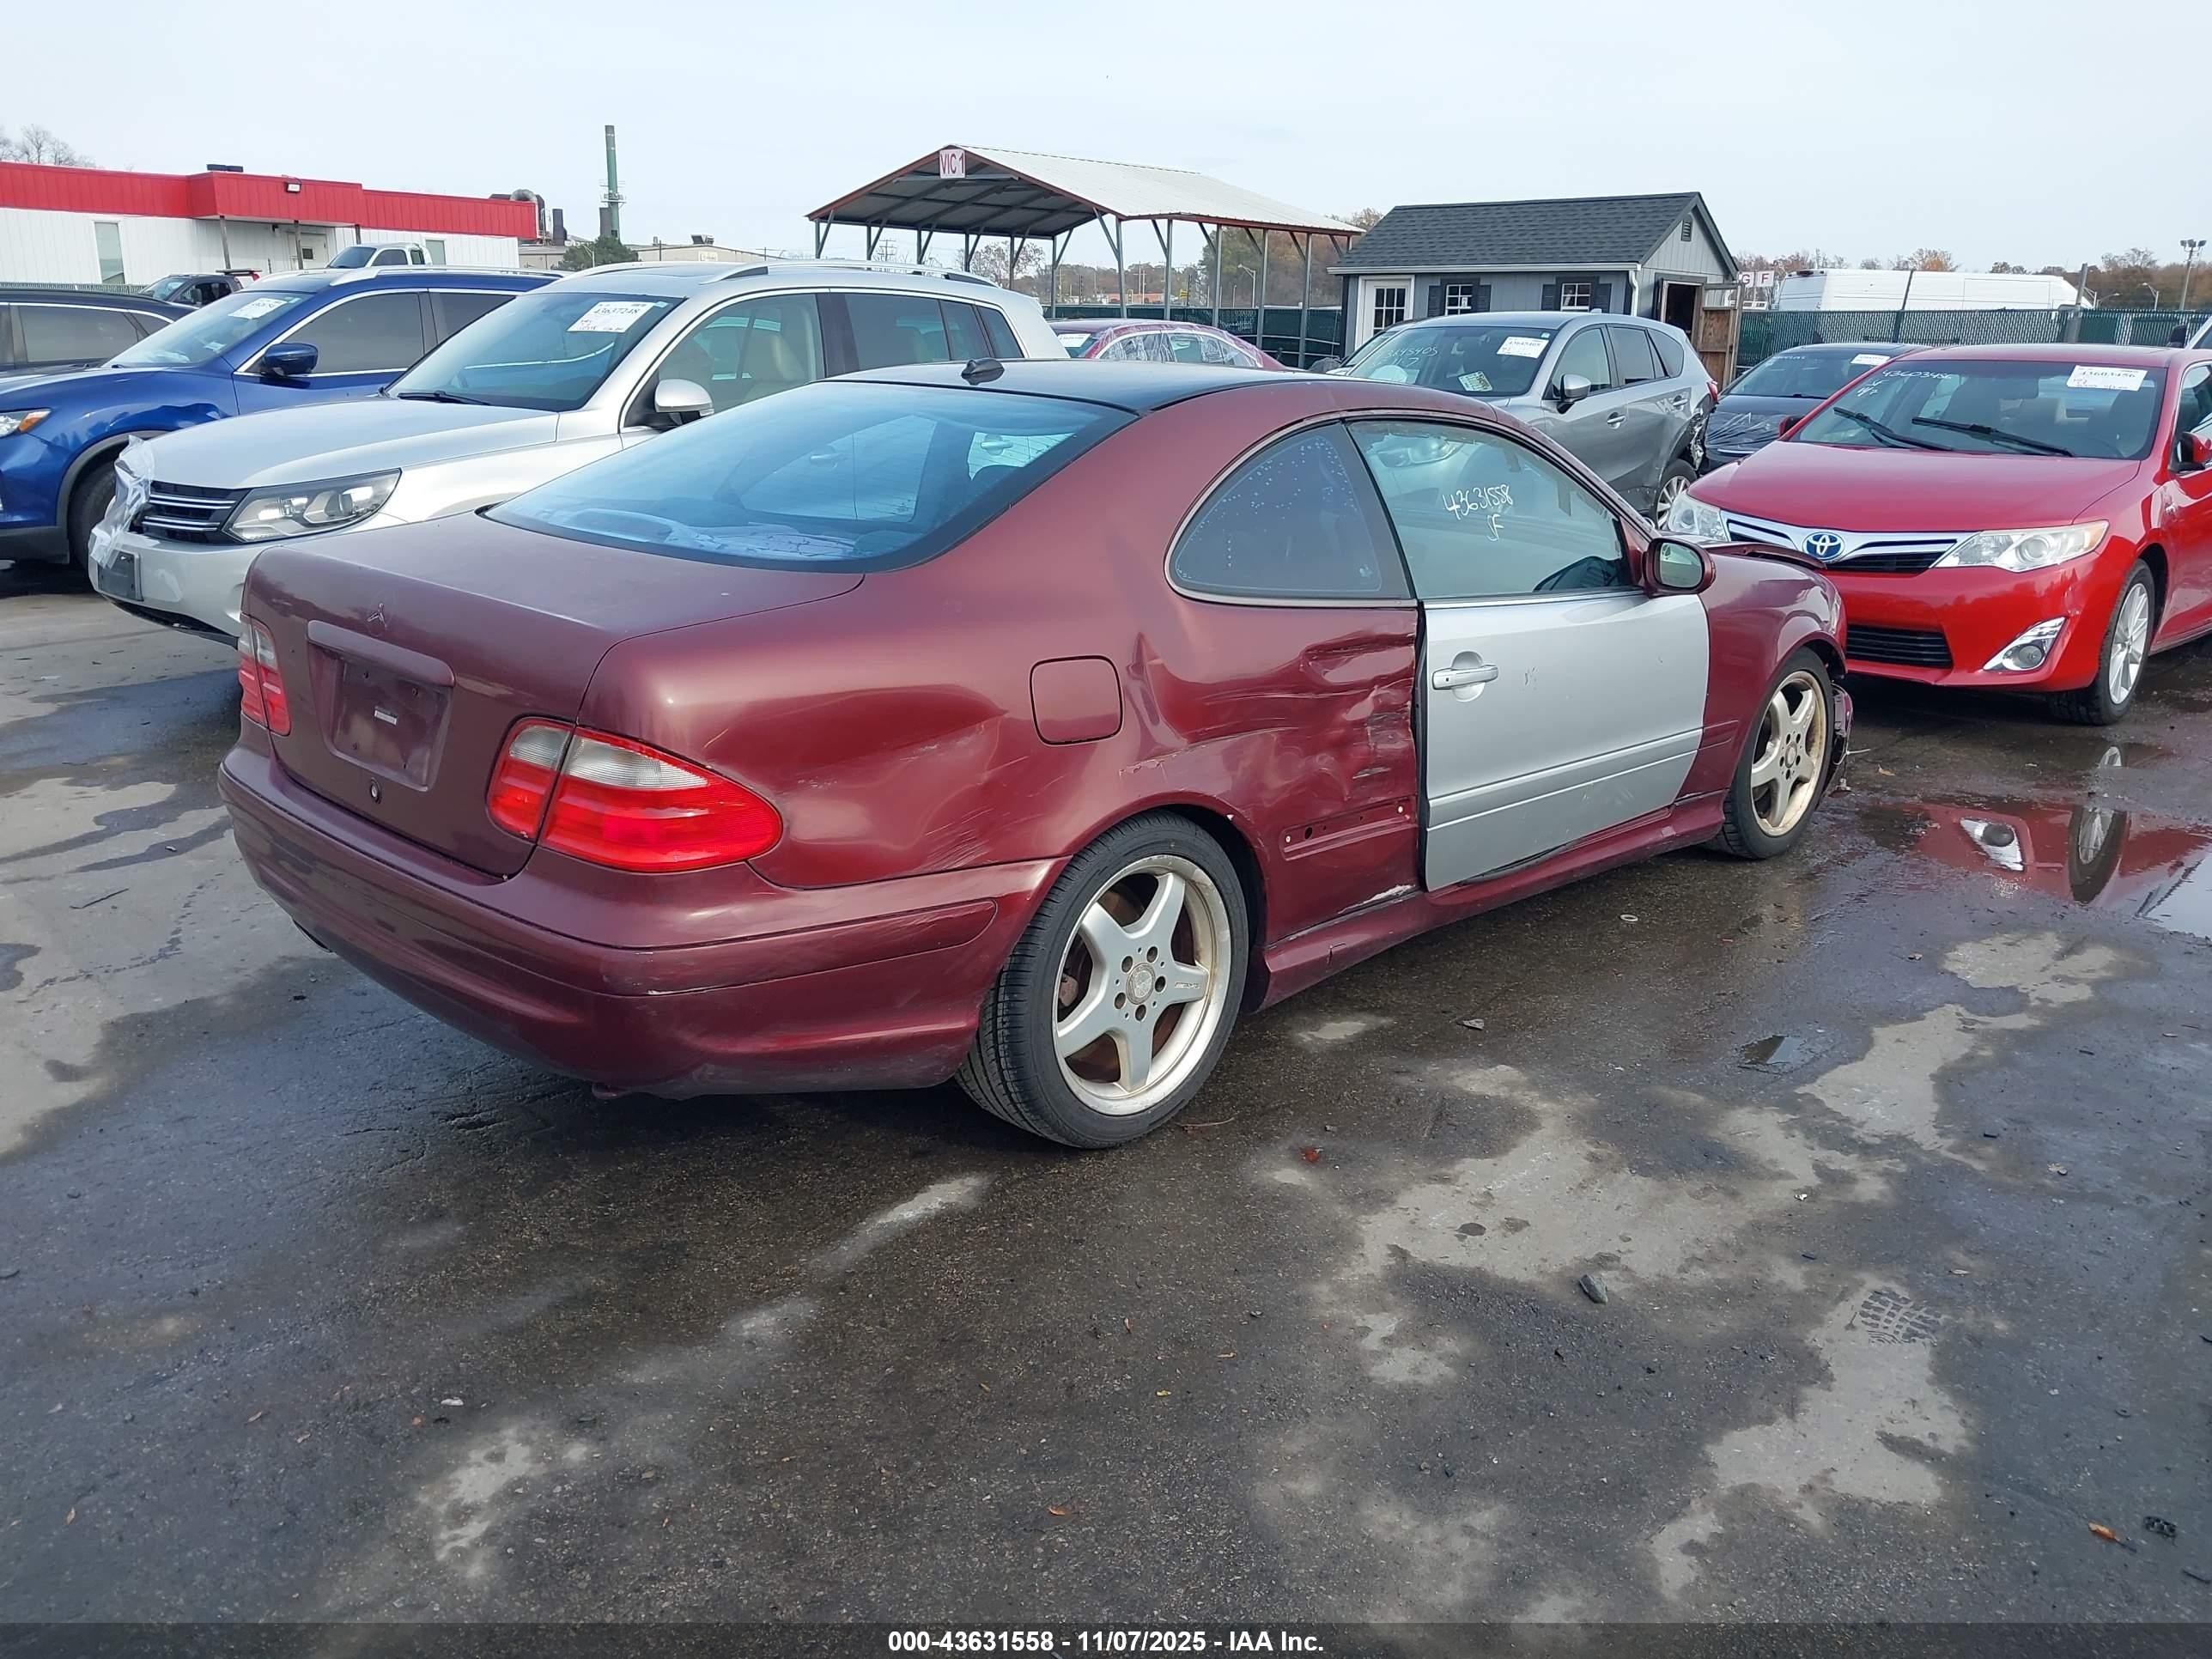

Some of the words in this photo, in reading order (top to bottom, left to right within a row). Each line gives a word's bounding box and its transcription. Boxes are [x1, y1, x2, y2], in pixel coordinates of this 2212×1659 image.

[940, 153, 957, 174] VIC
[959, 152, 963, 174] 1
[1742, 274, 1751, 284] G
[1761, 273, 1770, 284] F
[1442, 483, 1513, 520] 43631558
